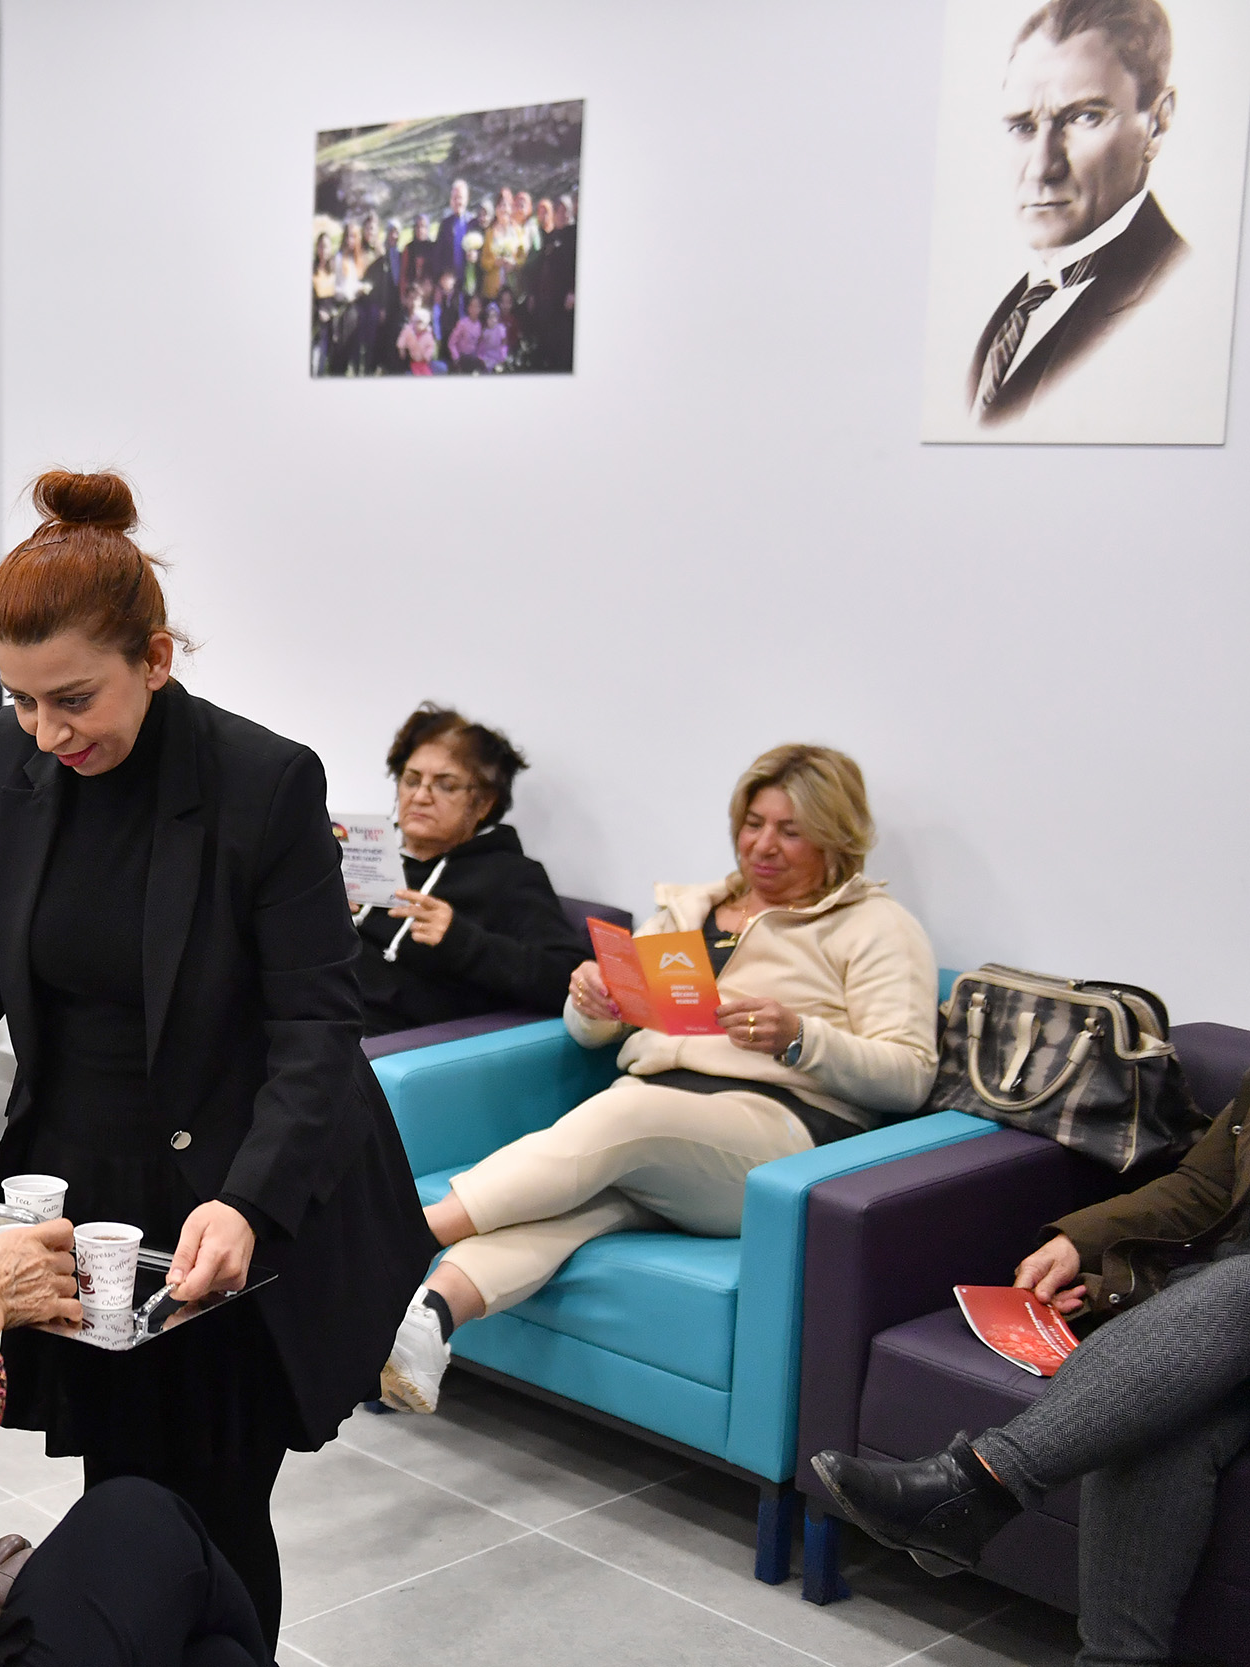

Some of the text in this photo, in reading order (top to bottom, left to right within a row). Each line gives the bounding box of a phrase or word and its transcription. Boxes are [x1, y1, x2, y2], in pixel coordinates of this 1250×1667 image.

[15, 1196, 31, 1206] Tea
[84, 1250, 117, 1261] Espresso
[109, 1257, 131, 1272] Coffee
